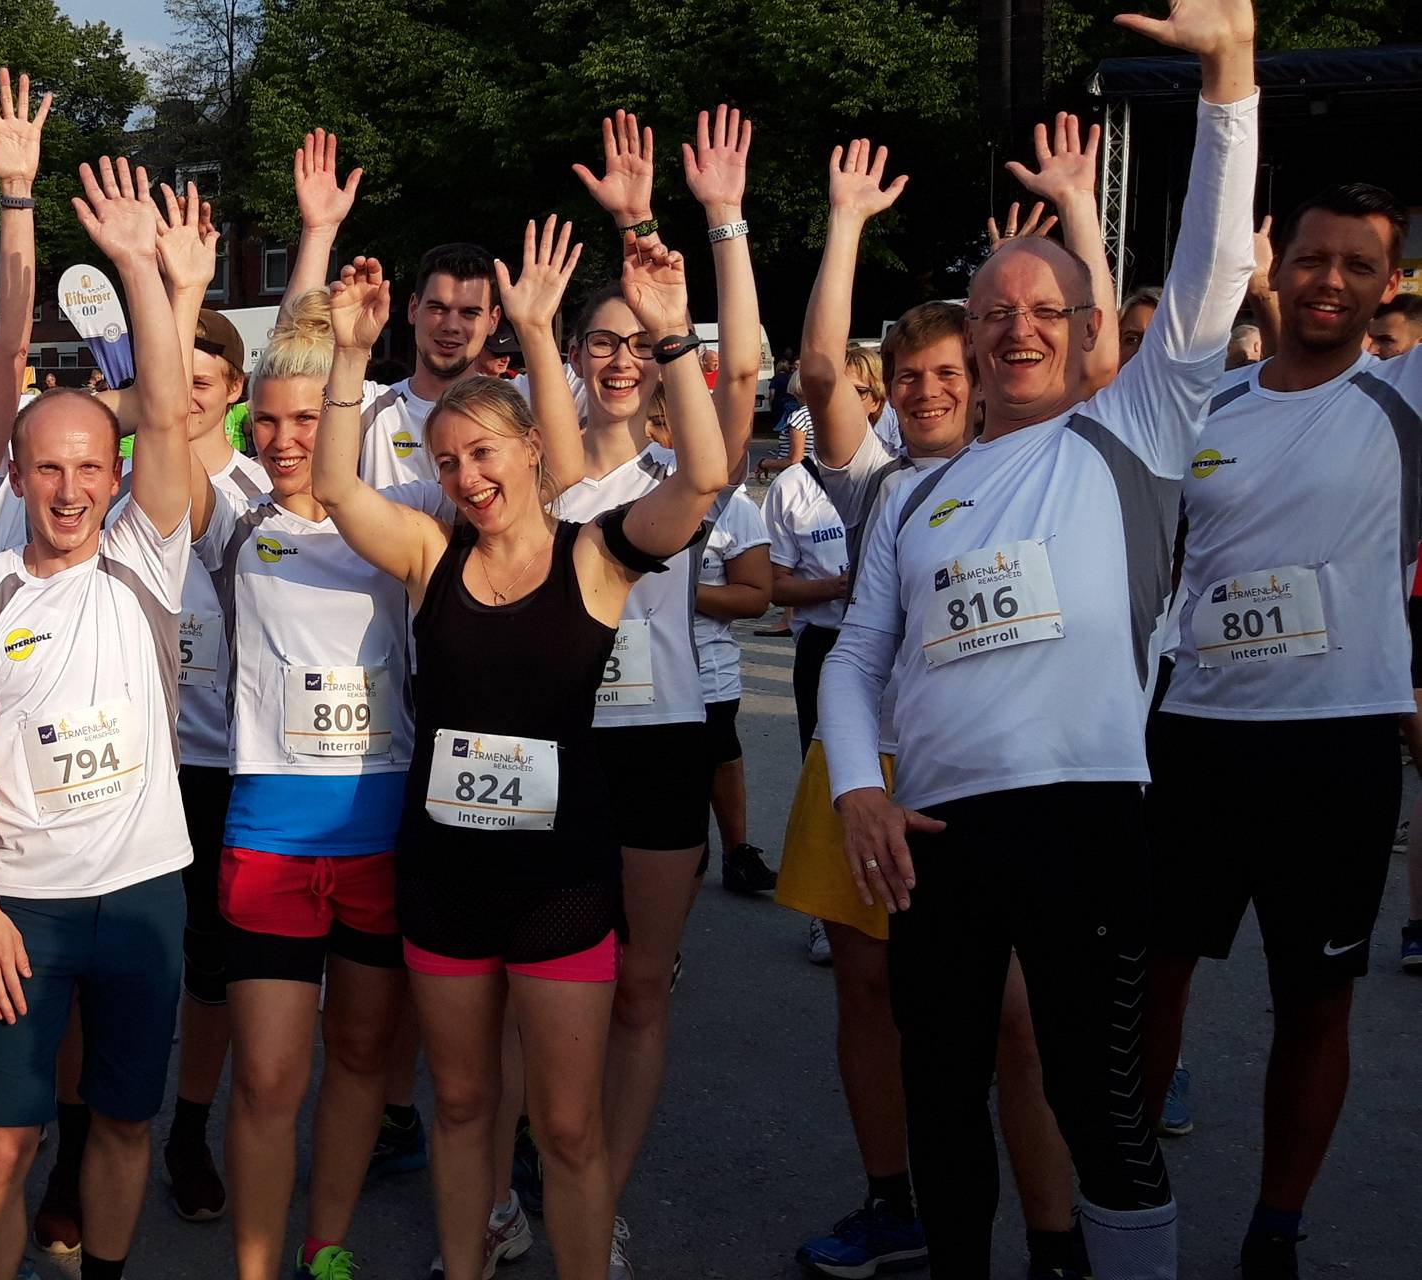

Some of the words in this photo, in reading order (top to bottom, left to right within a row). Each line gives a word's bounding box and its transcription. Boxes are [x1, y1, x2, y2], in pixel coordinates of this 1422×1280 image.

[65, 291, 111, 307] Bitburger
[929, 500, 975, 521] INTEROLL
[811, 526, 843, 543] Haus
[950, 560, 1020, 585] FIRMENLAUF
[978, 571, 1022, 585] REMSCHEID
[1228, 583, 1291, 600] FIRMENLAUF
[947, 586, 1018, 631] 816
[1222, 606, 1283, 640] 801
[5, 633, 52, 652] INTERROLL
[959, 627, 1019, 652] Interroll
[1231, 643, 1287, 660] Interroll
[313, 703, 370, 732] 809
[58, 718, 118, 740] FIRMENLAUF
[318, 740, 367, 751] Interroll
[53, 742, 120, 784] 794
[468, 750, 534, 764] FIRMENLAUF
[493, 763, 533, 772] REMSCHEID
[68, 781, 121, 804] Interroll
[456, 772, 522, 806] 824
[458, 811, 515, 826] Interroll
